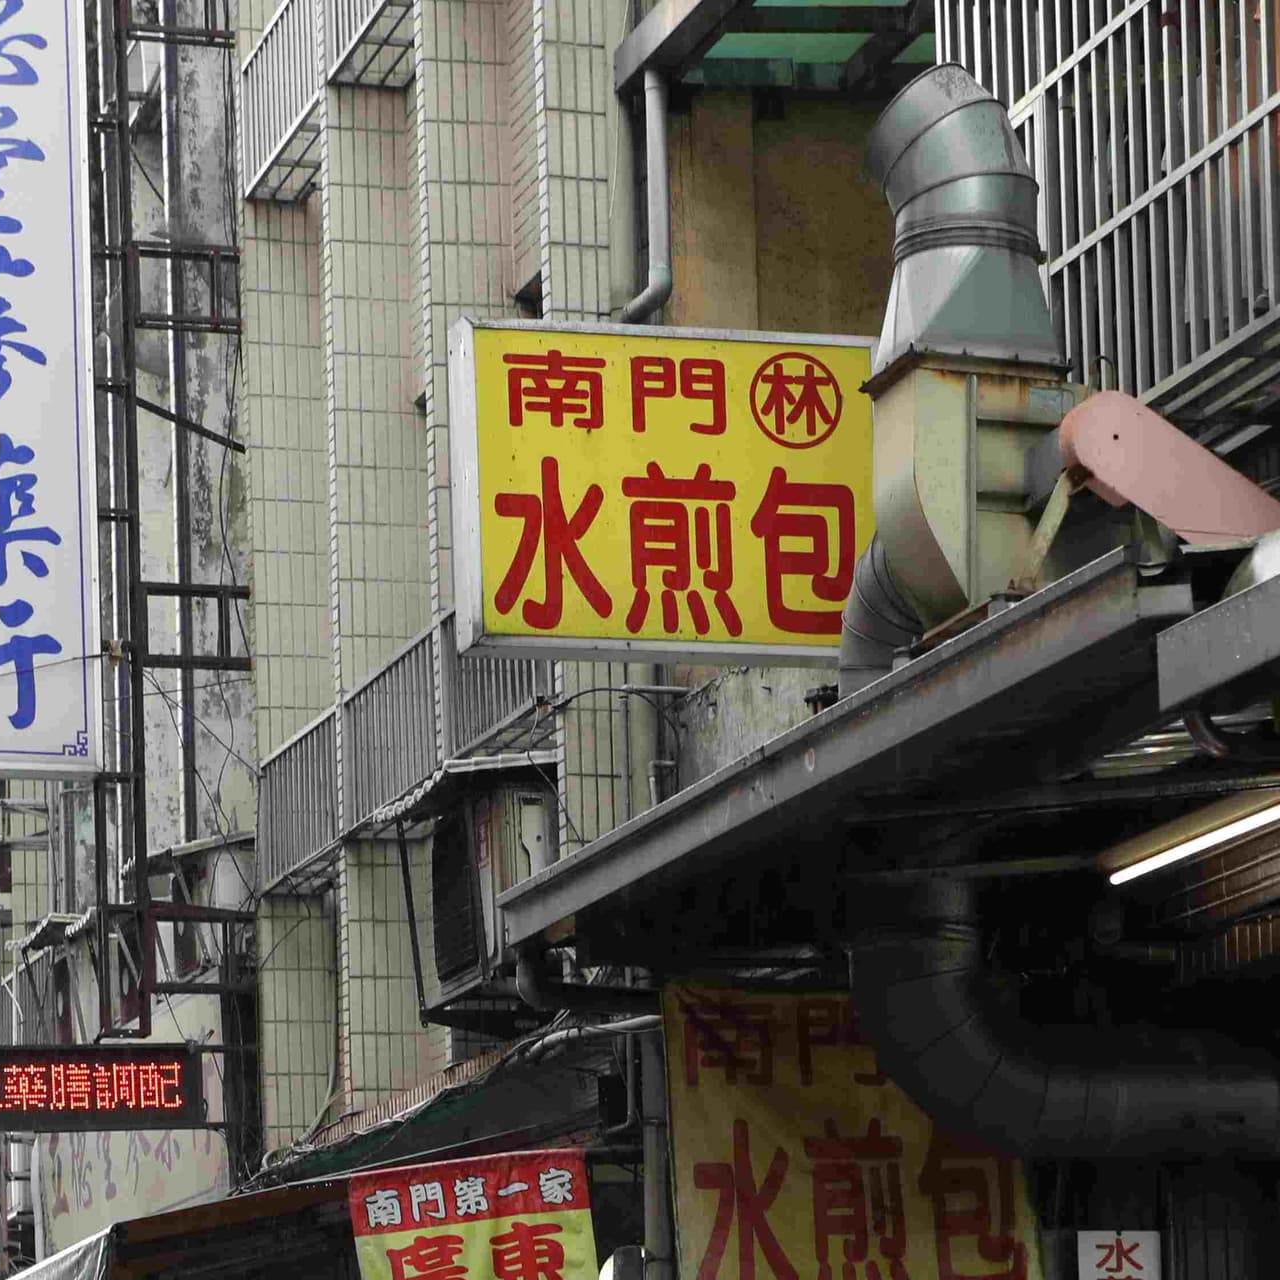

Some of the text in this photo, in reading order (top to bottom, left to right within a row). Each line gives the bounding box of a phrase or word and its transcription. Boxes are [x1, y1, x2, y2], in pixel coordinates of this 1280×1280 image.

[493, 455, 856, 638] 水煎包
[364, 1166, 575, 1229] 南門第一家
